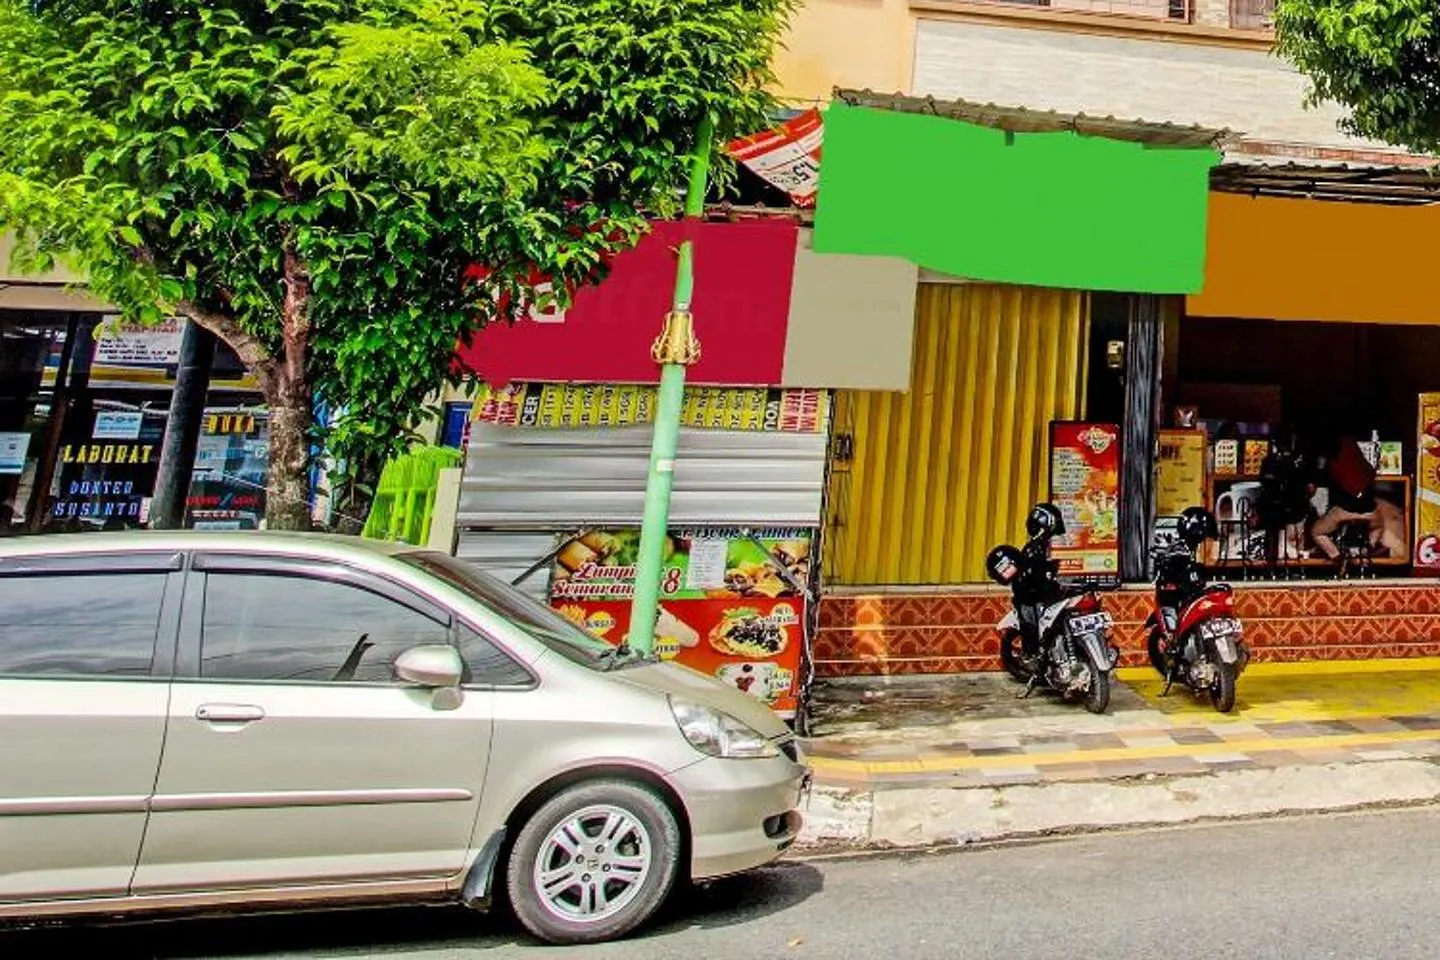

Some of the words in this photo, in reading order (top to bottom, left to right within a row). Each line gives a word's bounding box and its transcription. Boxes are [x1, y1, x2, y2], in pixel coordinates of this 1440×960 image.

[207, 414, 255, 434] BUKA
[62, 444, 153, 464] LABORAT
[70, 480, 134, 495] DOKTER
[54, 501, 138, 517] SUSANTO
[572, 561, 637, 581] Lumpi
